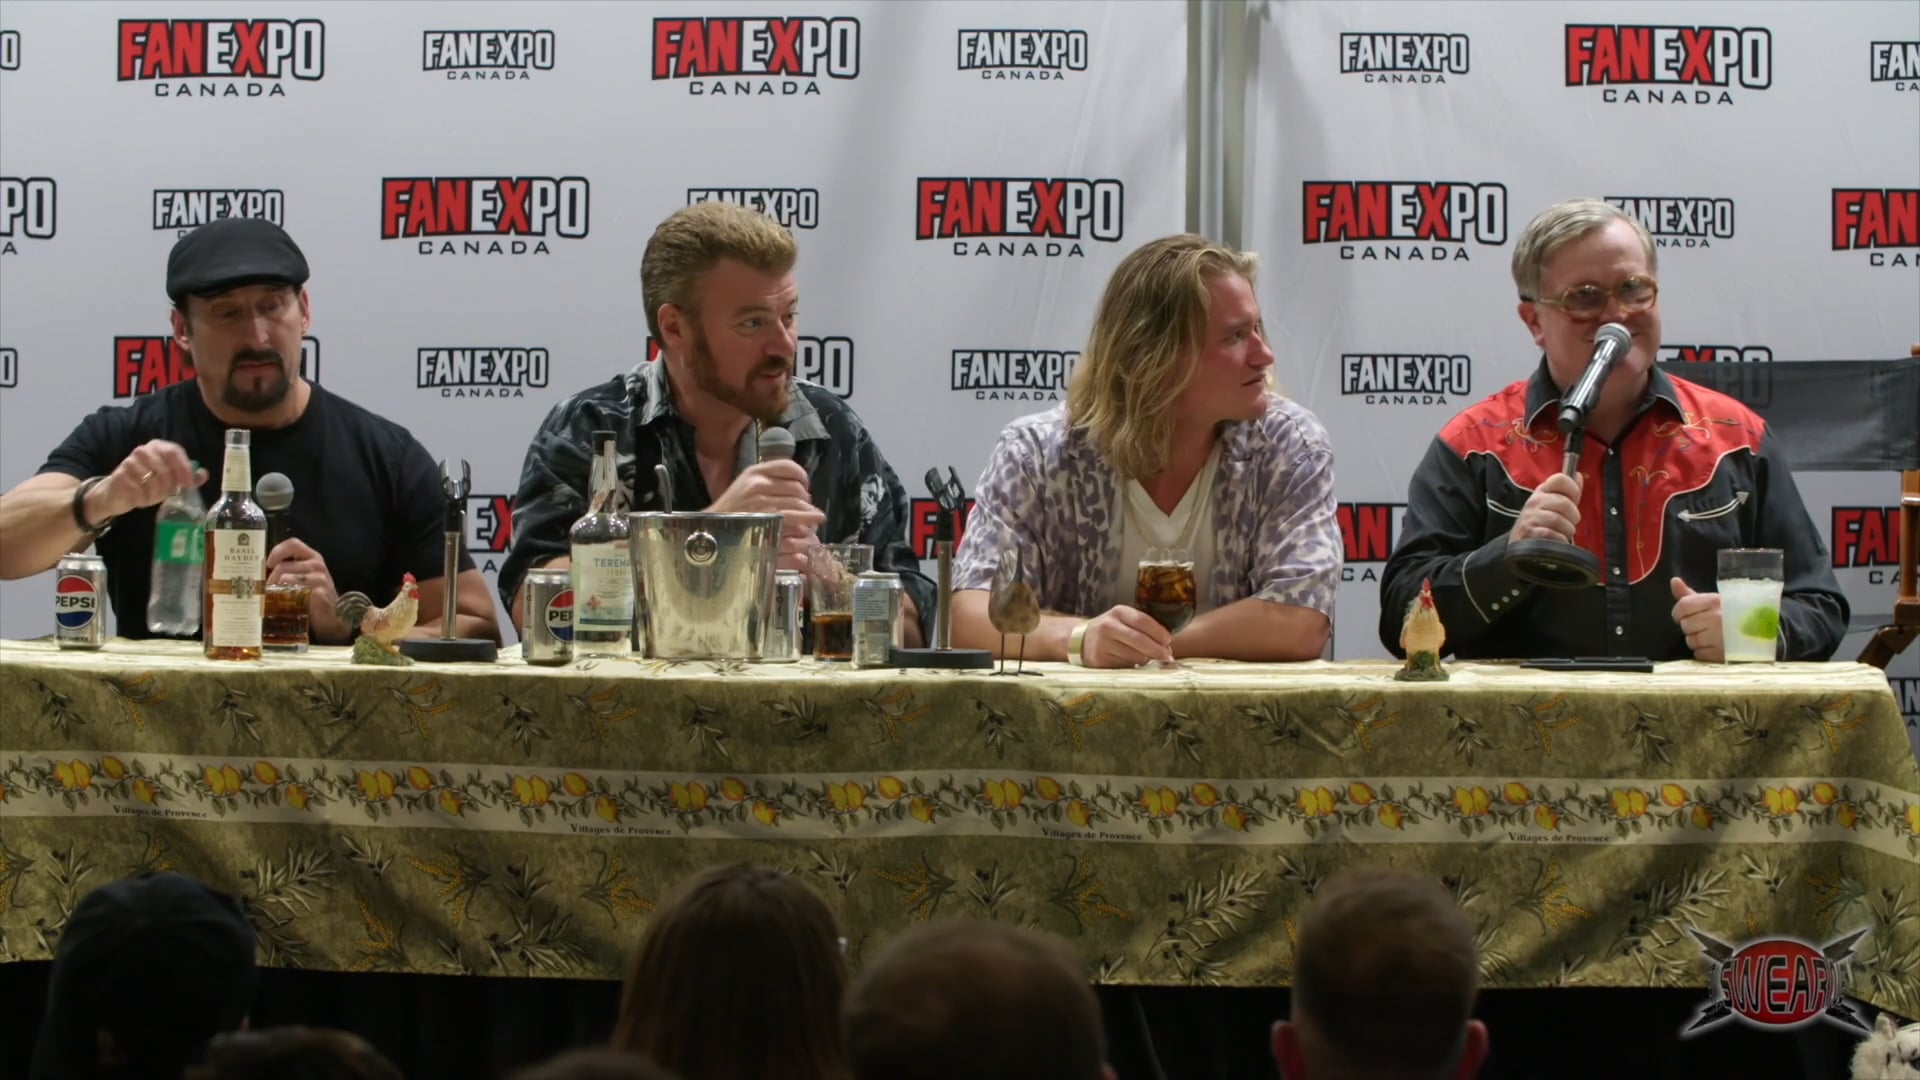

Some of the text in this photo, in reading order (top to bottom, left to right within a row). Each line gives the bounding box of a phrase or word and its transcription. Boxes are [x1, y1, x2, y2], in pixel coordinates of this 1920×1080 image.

[447, 71, 530, 80] CANADA
[981, 70, 1064, 80] CANADA
[1364, 74, 1446, 83] CANADA
[154, 83, 286, 97] CANADA
[689, 81, 821, 95] CANADA
[1603, 89, 1734, 105] CANADA
[418, 241, 550, 255] CANADA
[1656, 239, 1711, 248] NADA
[953, 243, 1085, 258] CANADA
[1340, 246, 1470, 262] CANADA
[441, 388, 524, 398] CANADA
[976, 391, 1058, 400] CANADA
[1366, 395, 1447, 405] CANADA
[112, 805, 207, 818] Villages de Provence
[571, 823, 672, 836] Villages de Provence
[1042, 827, 1142, 840] Villages de Provence
